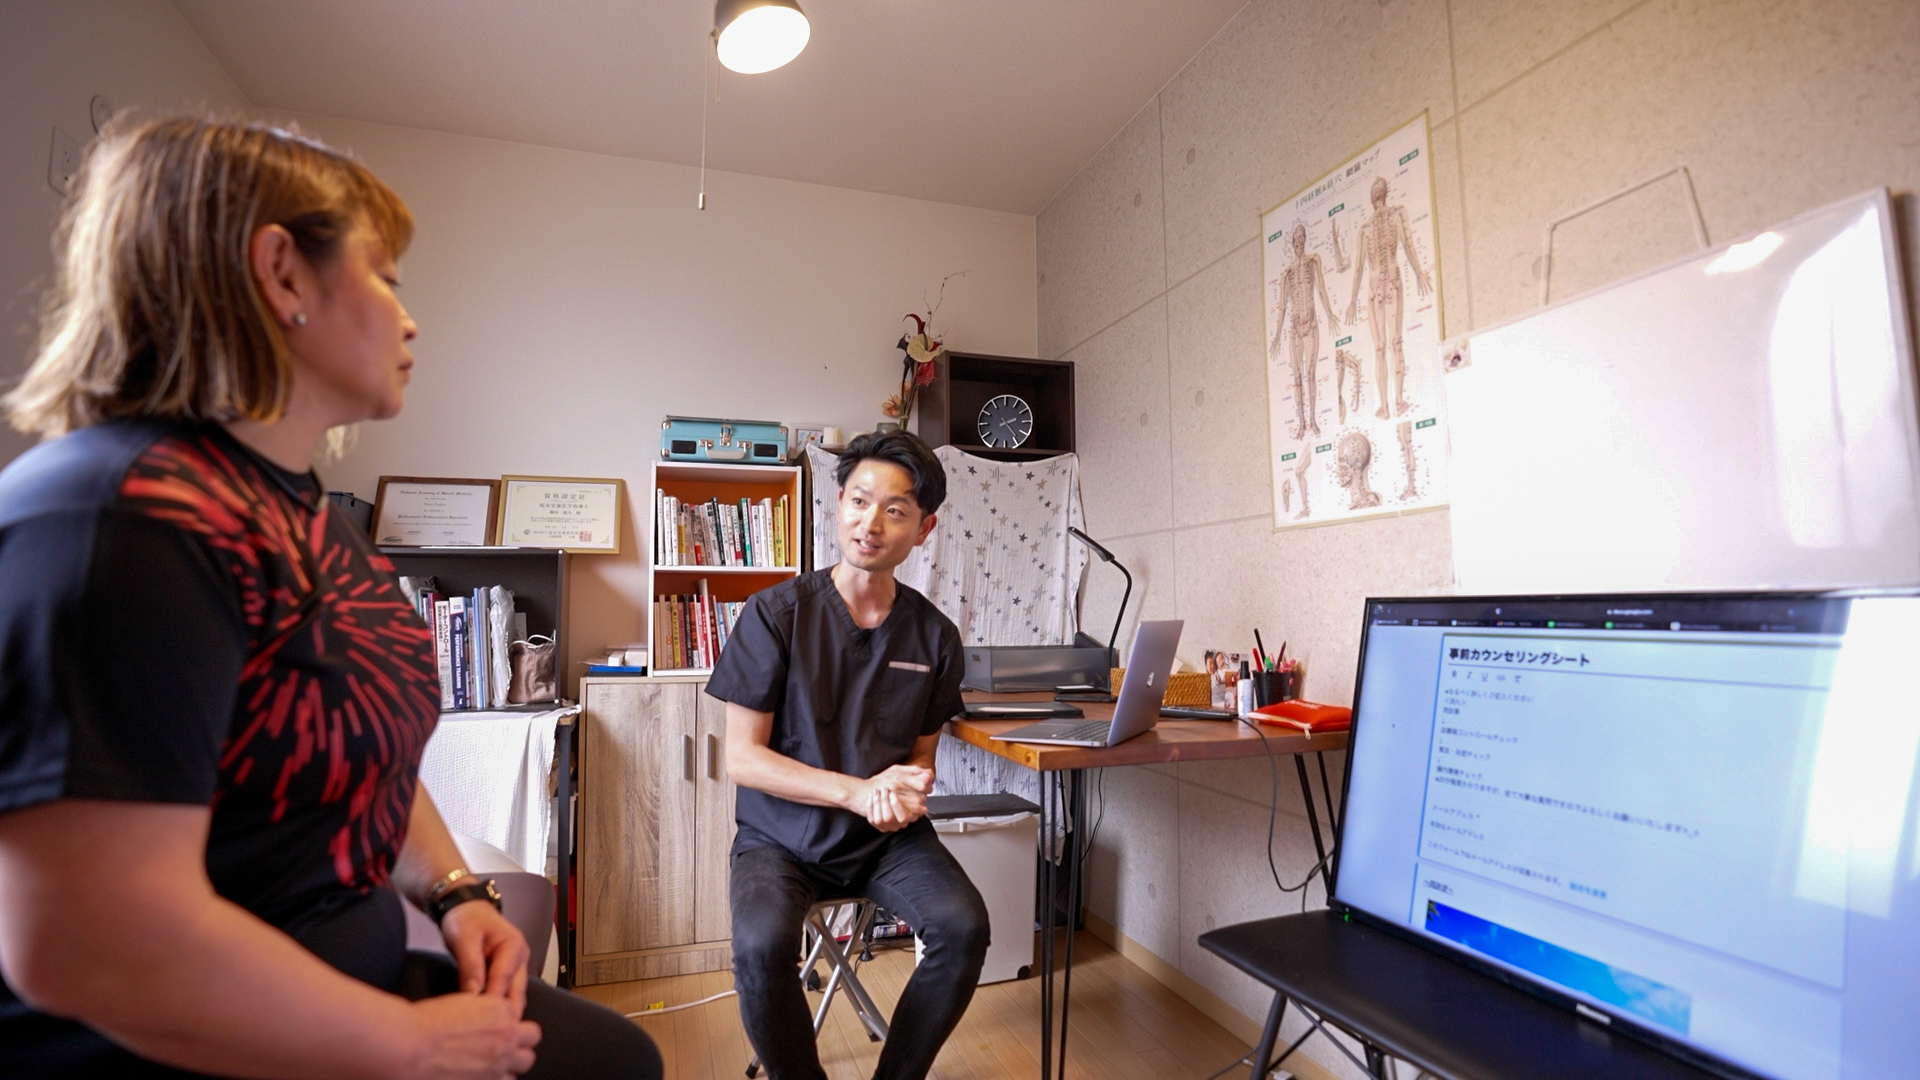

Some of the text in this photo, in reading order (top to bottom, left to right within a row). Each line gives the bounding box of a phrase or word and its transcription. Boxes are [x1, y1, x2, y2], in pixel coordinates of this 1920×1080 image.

[1448, 647, 1591, 668] 事前カウンセリングシート
